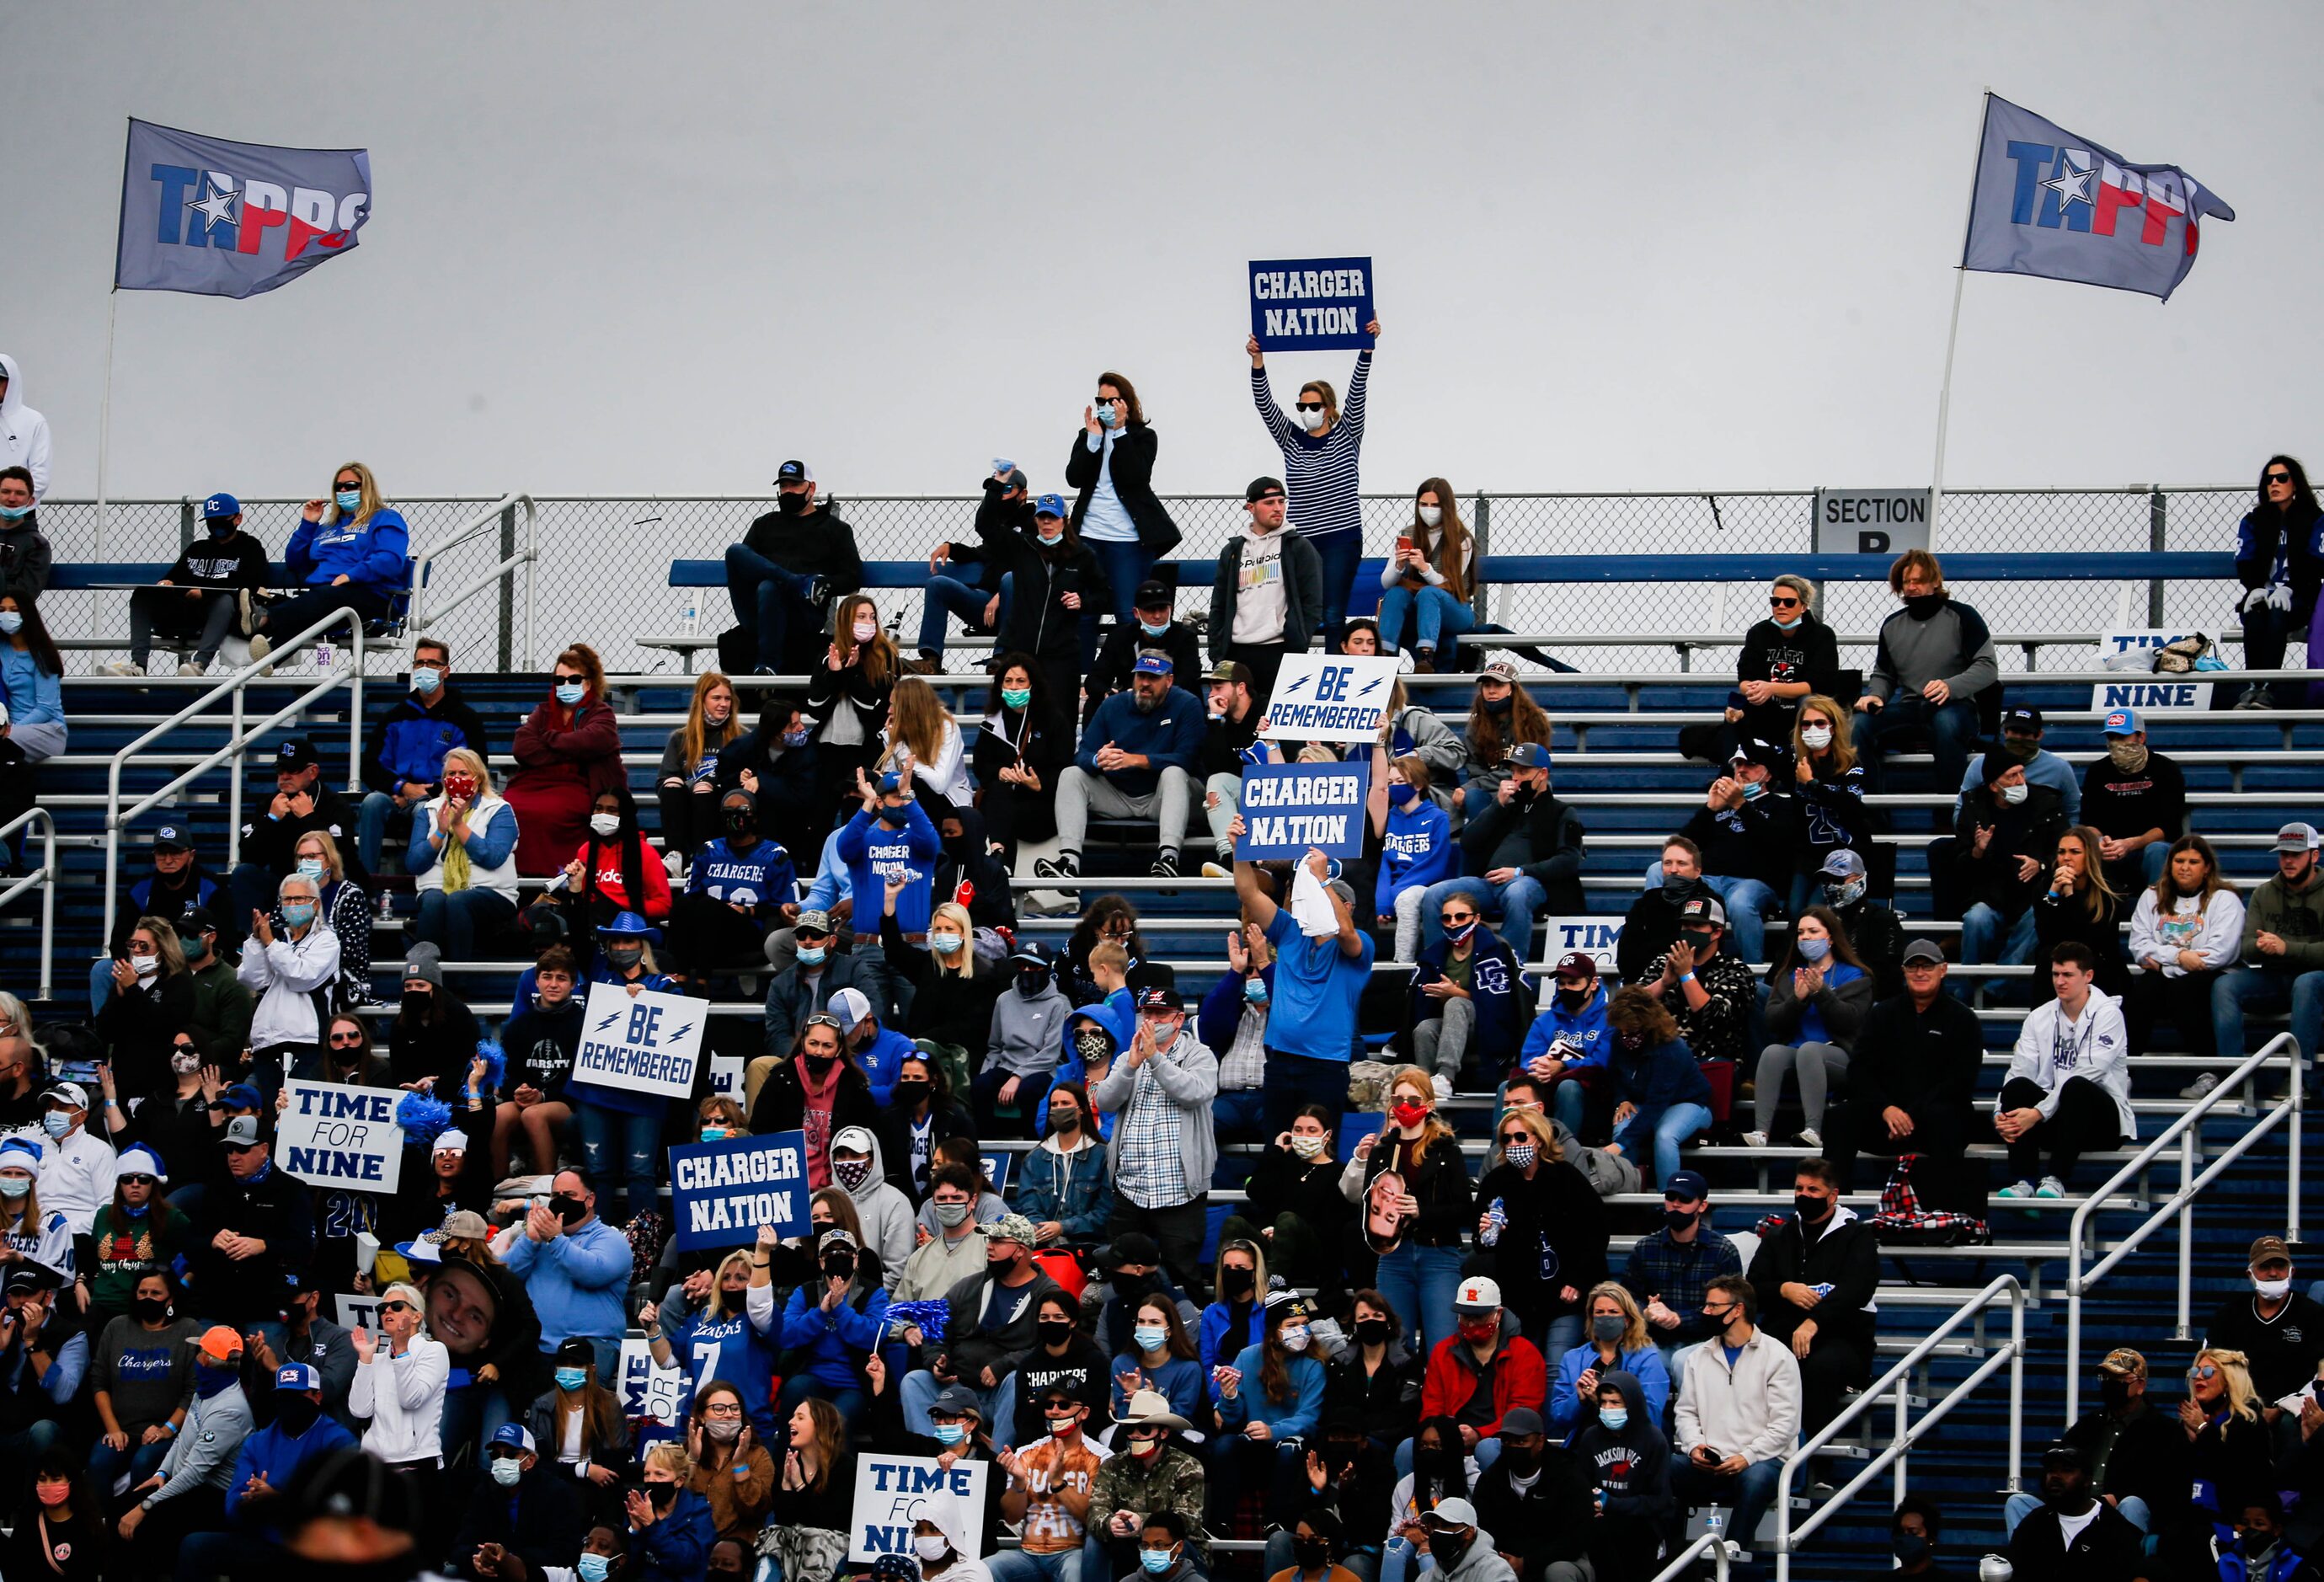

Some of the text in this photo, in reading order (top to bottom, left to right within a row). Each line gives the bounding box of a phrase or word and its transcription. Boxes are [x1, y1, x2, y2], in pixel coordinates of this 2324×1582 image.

[1254, 270, 1365, 300] CHARGER
[1265, 307, 1358, 336] NATION
[1826, 498, 1926, 523] SECTION
[2112, 635, 2183, 654] TIM
[1316, 666, 1353, 702] BE
[2103, 684, 2196, 708] NINE
[1269, 703, 1381, 730] REMEMBERED
[1245, 776, 1359, 808] CHARGER
[1250, 815, 1348, 847] NATION
[708, 863, 764, 883] CHARGERS
[1559, 924, 1624, 949] TIM
[626, 1003, 663, 1047] BE
[526, 1058, 571, 1069] VARSITY
[580, 1041, 692, 1085] REMEMBERED
[296, 1088, 392, 1123] TIME
[312, 1121, 368, 1148] FOR
[286, 1146, 385, 1181] NINE
[677, 1146, 801, 1190] CHARGER
[689, 1190, 793, 1232] NATION
[117, 1354, 174, 1371] Chargers
[692, 1341, 722, 1392] 7
[649, 1377, 675, 1419] OR
[1594, 1446, 1626, 1467] JACKSON
[870, 1463, 972, 1496] TIME
